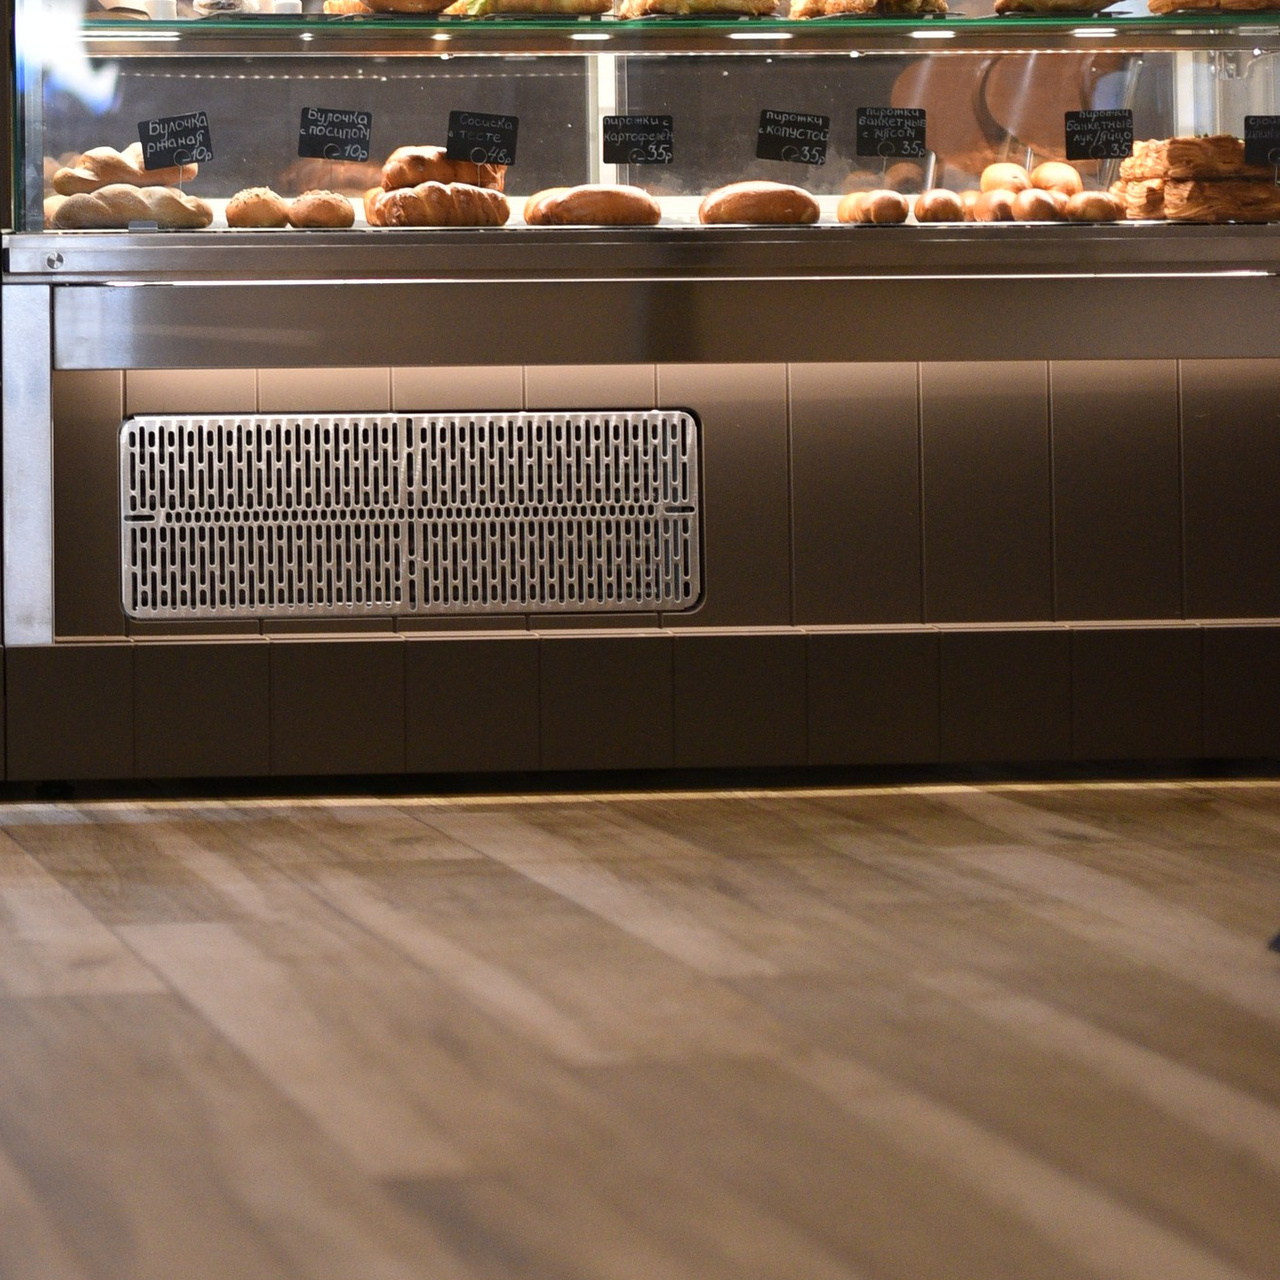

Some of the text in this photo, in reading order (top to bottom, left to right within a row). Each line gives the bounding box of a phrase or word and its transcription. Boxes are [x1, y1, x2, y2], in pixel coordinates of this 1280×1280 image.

[149, 112, 207, 141] Булочка
[308, 108, 367, 126] Булочка
[147, 130, 204, 158] ржаная
